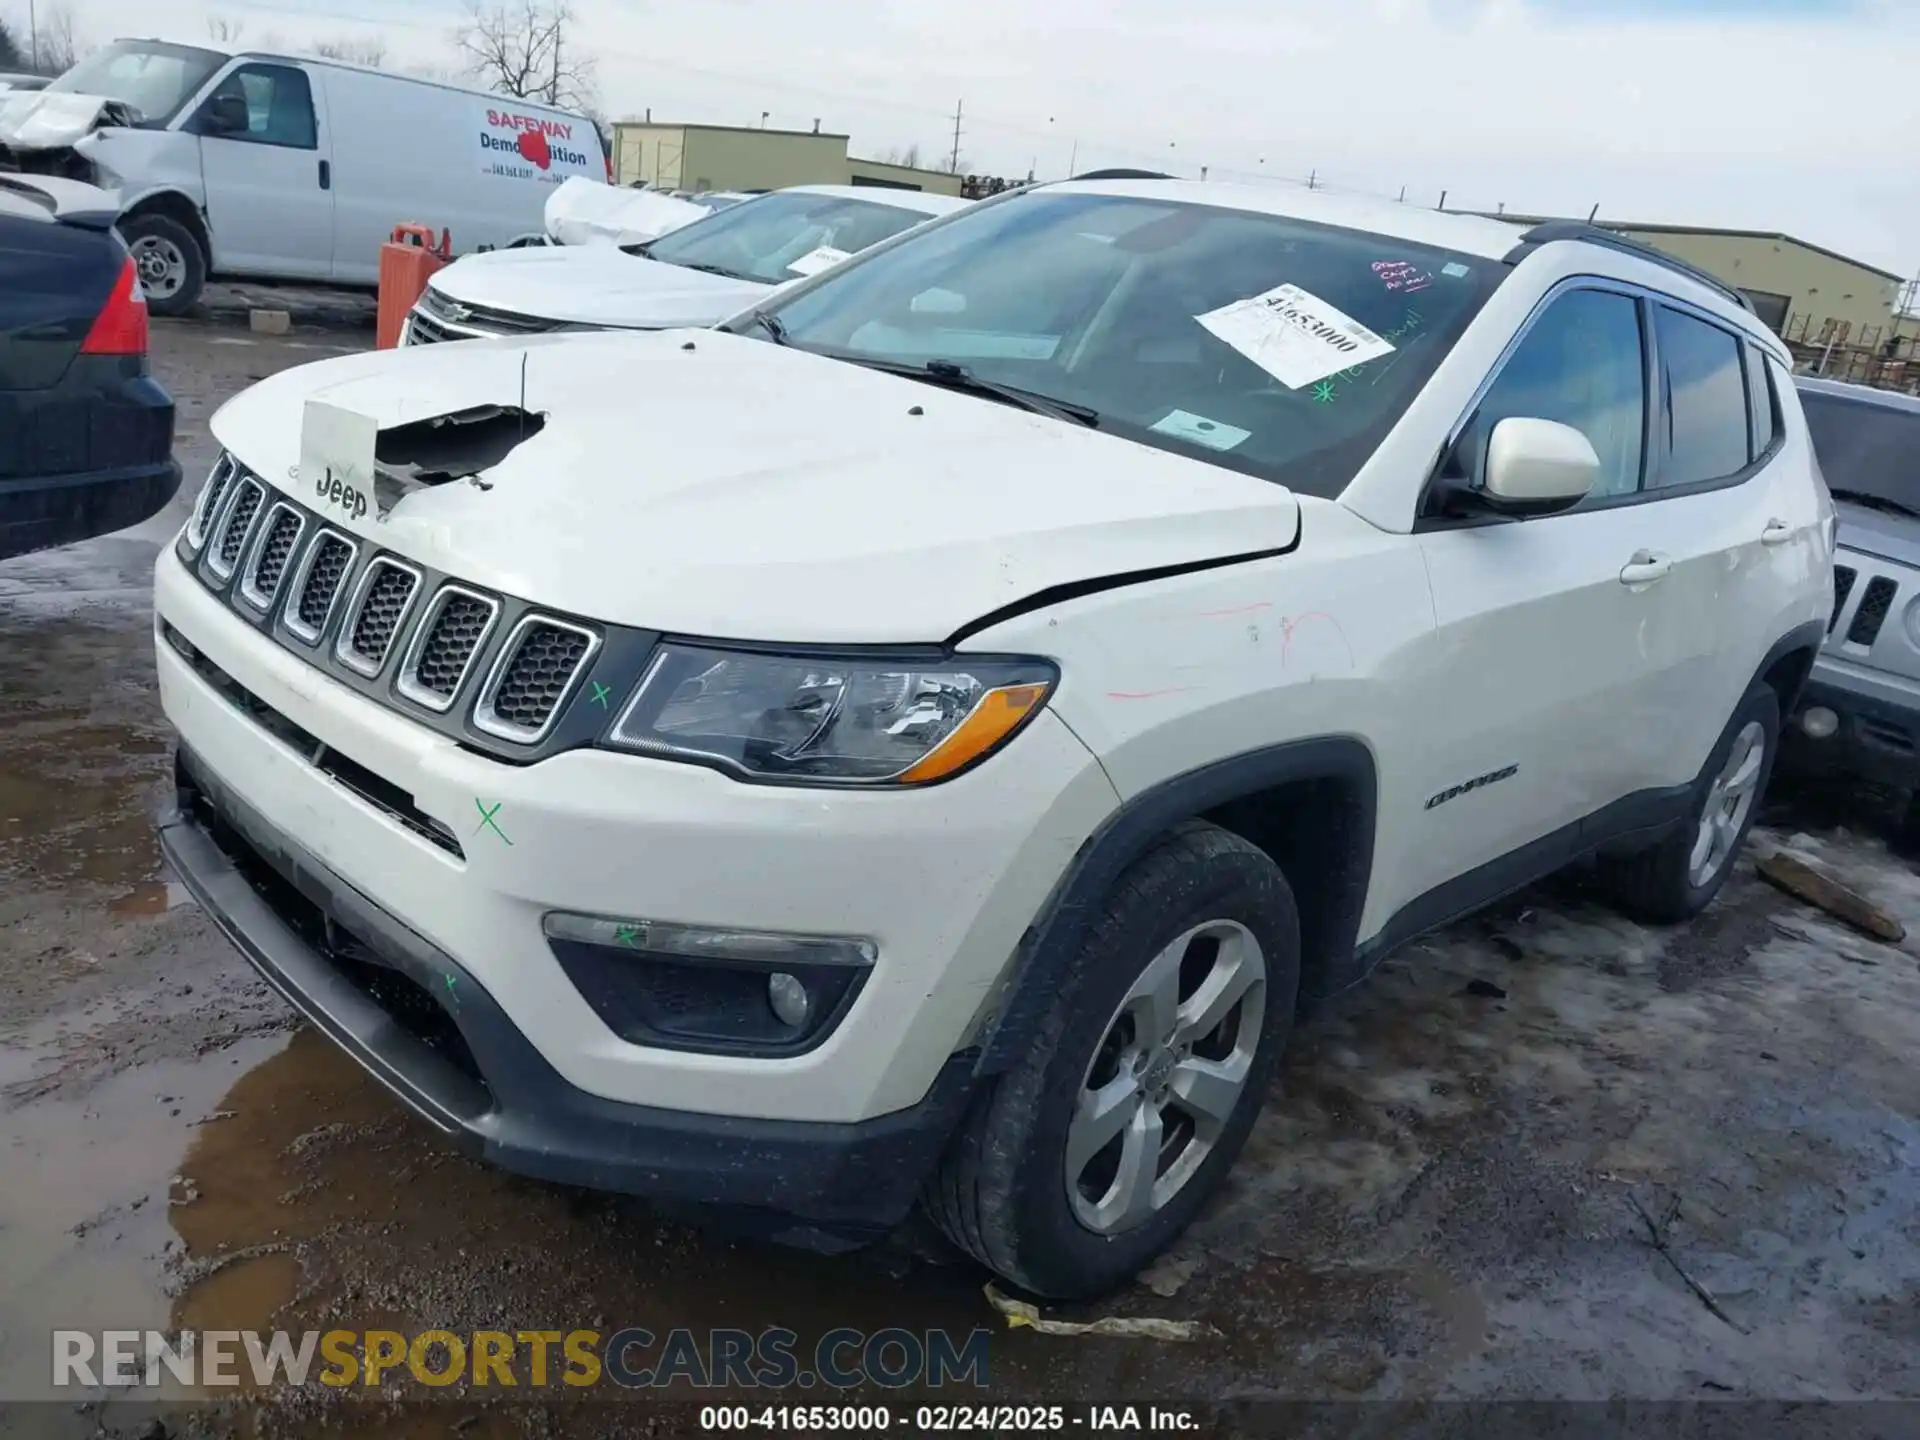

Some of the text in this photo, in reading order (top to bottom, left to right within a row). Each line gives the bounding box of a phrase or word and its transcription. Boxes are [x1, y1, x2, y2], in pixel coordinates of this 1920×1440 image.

[486, 109, 572, 140] SAFEWAY
[1266, 297, 1358, 353] 41653000
[316, 467, 367, 521] Jeep
